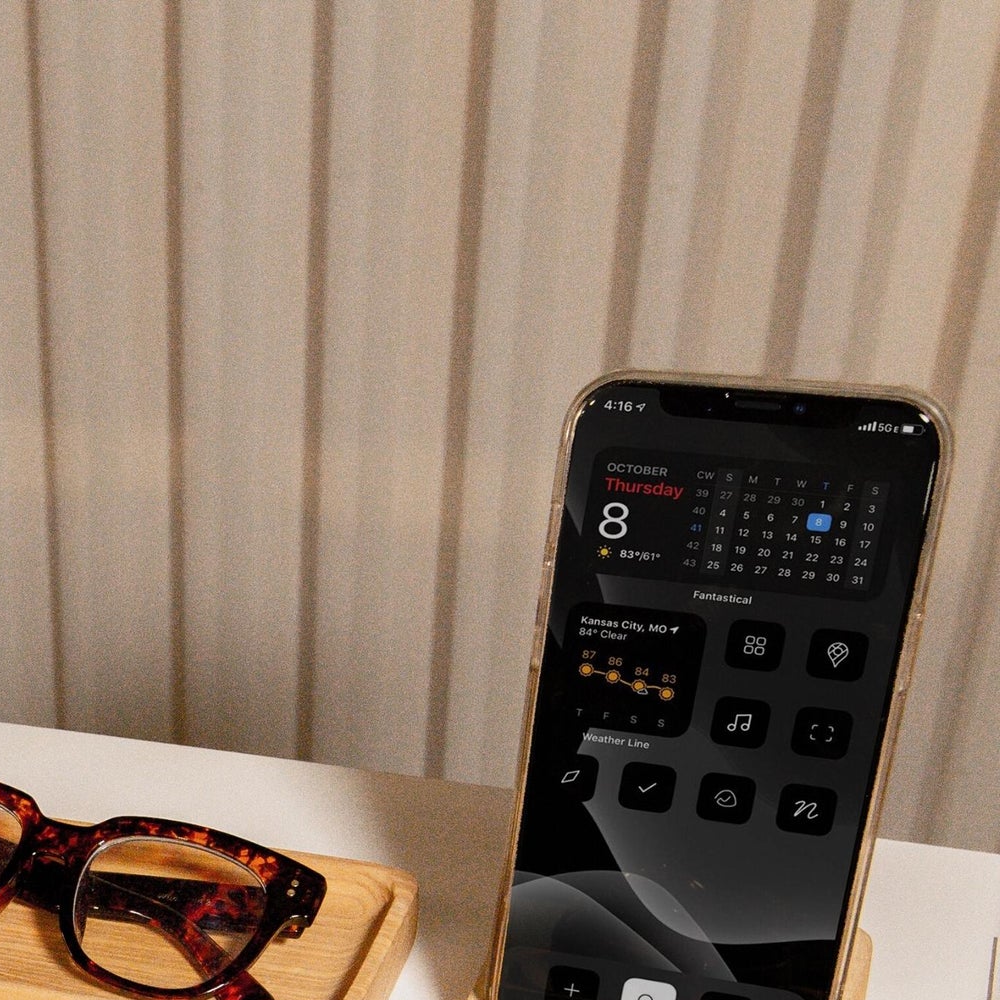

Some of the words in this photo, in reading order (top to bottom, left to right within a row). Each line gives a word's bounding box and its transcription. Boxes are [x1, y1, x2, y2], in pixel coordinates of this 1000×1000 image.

[603, 399, 633, 412] 4:16
[606, 462, 668, 477] OCTOBER
[605, 477, 684, 500] Thursday
[696, 470, 716, 480] CW
[725, 472, 734, 482] S
[748, 475, 759, 484] M
[774, 477, 782, 486] T
[796, 479, 808, 489] W
[823, 481, 830, 491] T
[846, 483, 854, 493] F
[871, 486, 880, 496] S
[695, 488, 710, 498] 39
[719, 490, 733, 500] 27
[743, 492, 757, 503] 28
[767, 495, 782, 505] 29
[791, 497, 805, 507] 30
[843, 502, 851, 512] 2
[868, 504, 876, 514] 3
[598, 501, 630, 540] 8
[692, 506, 706, 516] 40
[719, 508, 727, 517] 4
[743, 510, 750, 520] 5
[766, 513, 775, 522] 6
[791, 515, 799, 524] 7
[814, 516, 824, 527] 8
[839, 520, 848, 530] 9
[863, 522, 875, 532] 10
[690, 523, 702, 533] 41
[715, 526, 725, 535] 11
[738, 528, 750, 538] 12
[762, 530, 774, 540] 13
[786, 532, 798, 542] 14
[810, 535, 822, 545] 15
[834, 537, 847, 547] 16
[859, 540, 872, 549] 17
[686, 540, 700, 550] 42
[711, 543, 723, 553] 18
[734, 545, 747, 555] 19
[757, 547, 772, 558] 20
[781, 550, 794, 560] 21
[805, 552, 820, 563] 22
[829, 555, 844, 565] 23
[853, 557, 868, 567] 24
[682, 558, 697, 568] 43
[706, 560, 720, 570] 25
[730, 562, 744, 573] 26
[754, 565, 768, 575] 27
[777, 567, 792, 578] 28
[801, 570, 816, 580] 29
[825, 572, 841, 583] 30
[851, 575, 864, 585] 31
[692, 590, 753, 605] Fantastical
[578, 626, 598, 637] 84°
[599, 629, 628, 641] Clear
[580, 615, 619, 628] Kansas
[621, 620, 645, 633] City,
[648, 623, 668, 634] MO
[581, 649, 597, 660] 87
[607, 656, 623, 667] 86
[634, 666, 649, 677] 84
[661, 673, 677, 685] 83
[576, 707, 584, 717] T
[602, 711, 610, 720] F
[629, 714, 638, 725] S
[657, 718, 665, 728] S
[582, 732, 626, 746] Weather
[627, 738, 650, 749] Line
